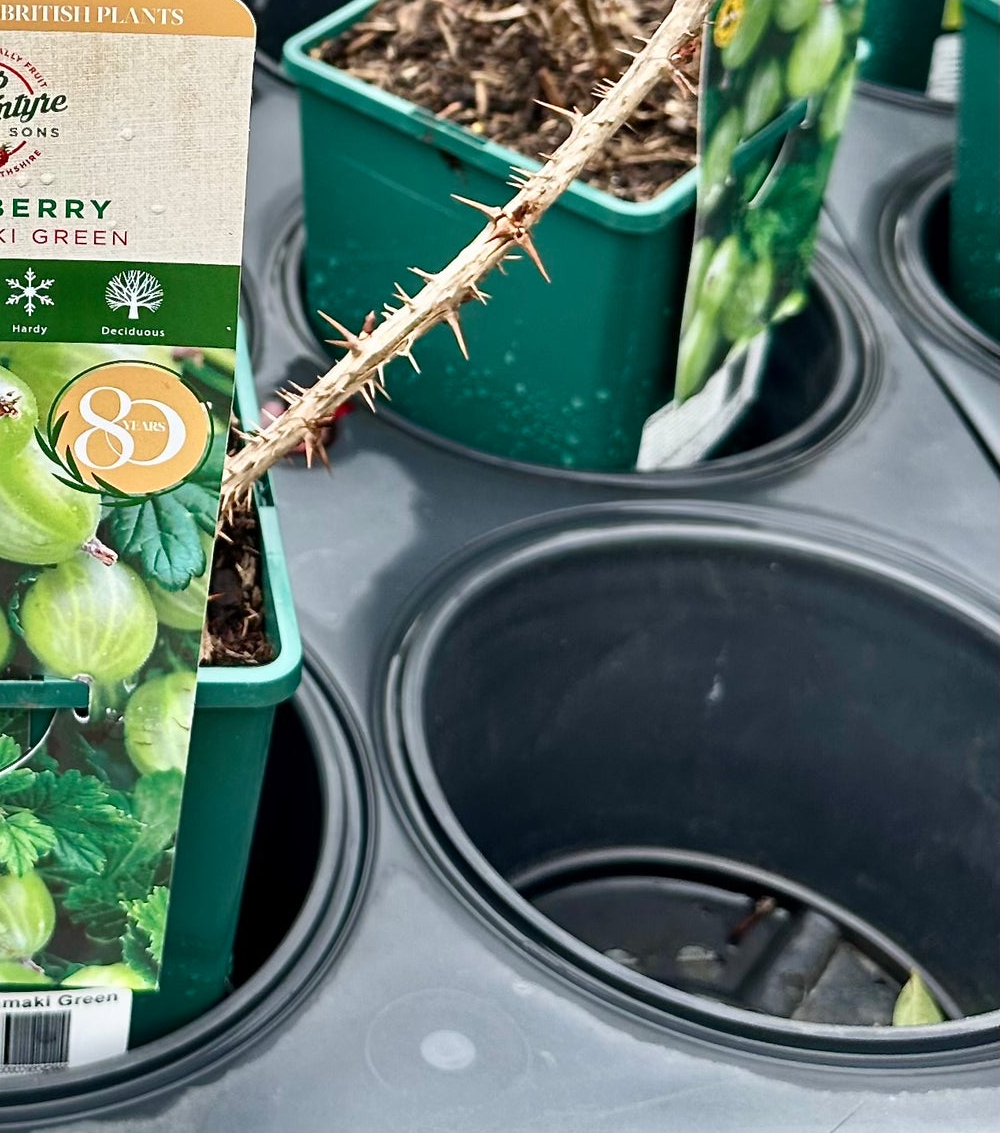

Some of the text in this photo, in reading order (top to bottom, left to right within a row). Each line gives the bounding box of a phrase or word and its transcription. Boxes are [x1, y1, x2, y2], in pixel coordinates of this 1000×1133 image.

[0, 4, 90, 23] BRITISH
[97, 6, 184, 25] PLANTS
[24, 61, 48, 88] FRUIT
[9, 127, 60, 138] SONS
[32, 228, 129, 246] GREEN
[12, 324, 48, 335] Hardy
[102, 326, 165, 337] Deciduous
[74, 386, 187, 470] 80
[122, 419, 167, 433] YEARS
[58, 991, 118, 1006] Green
